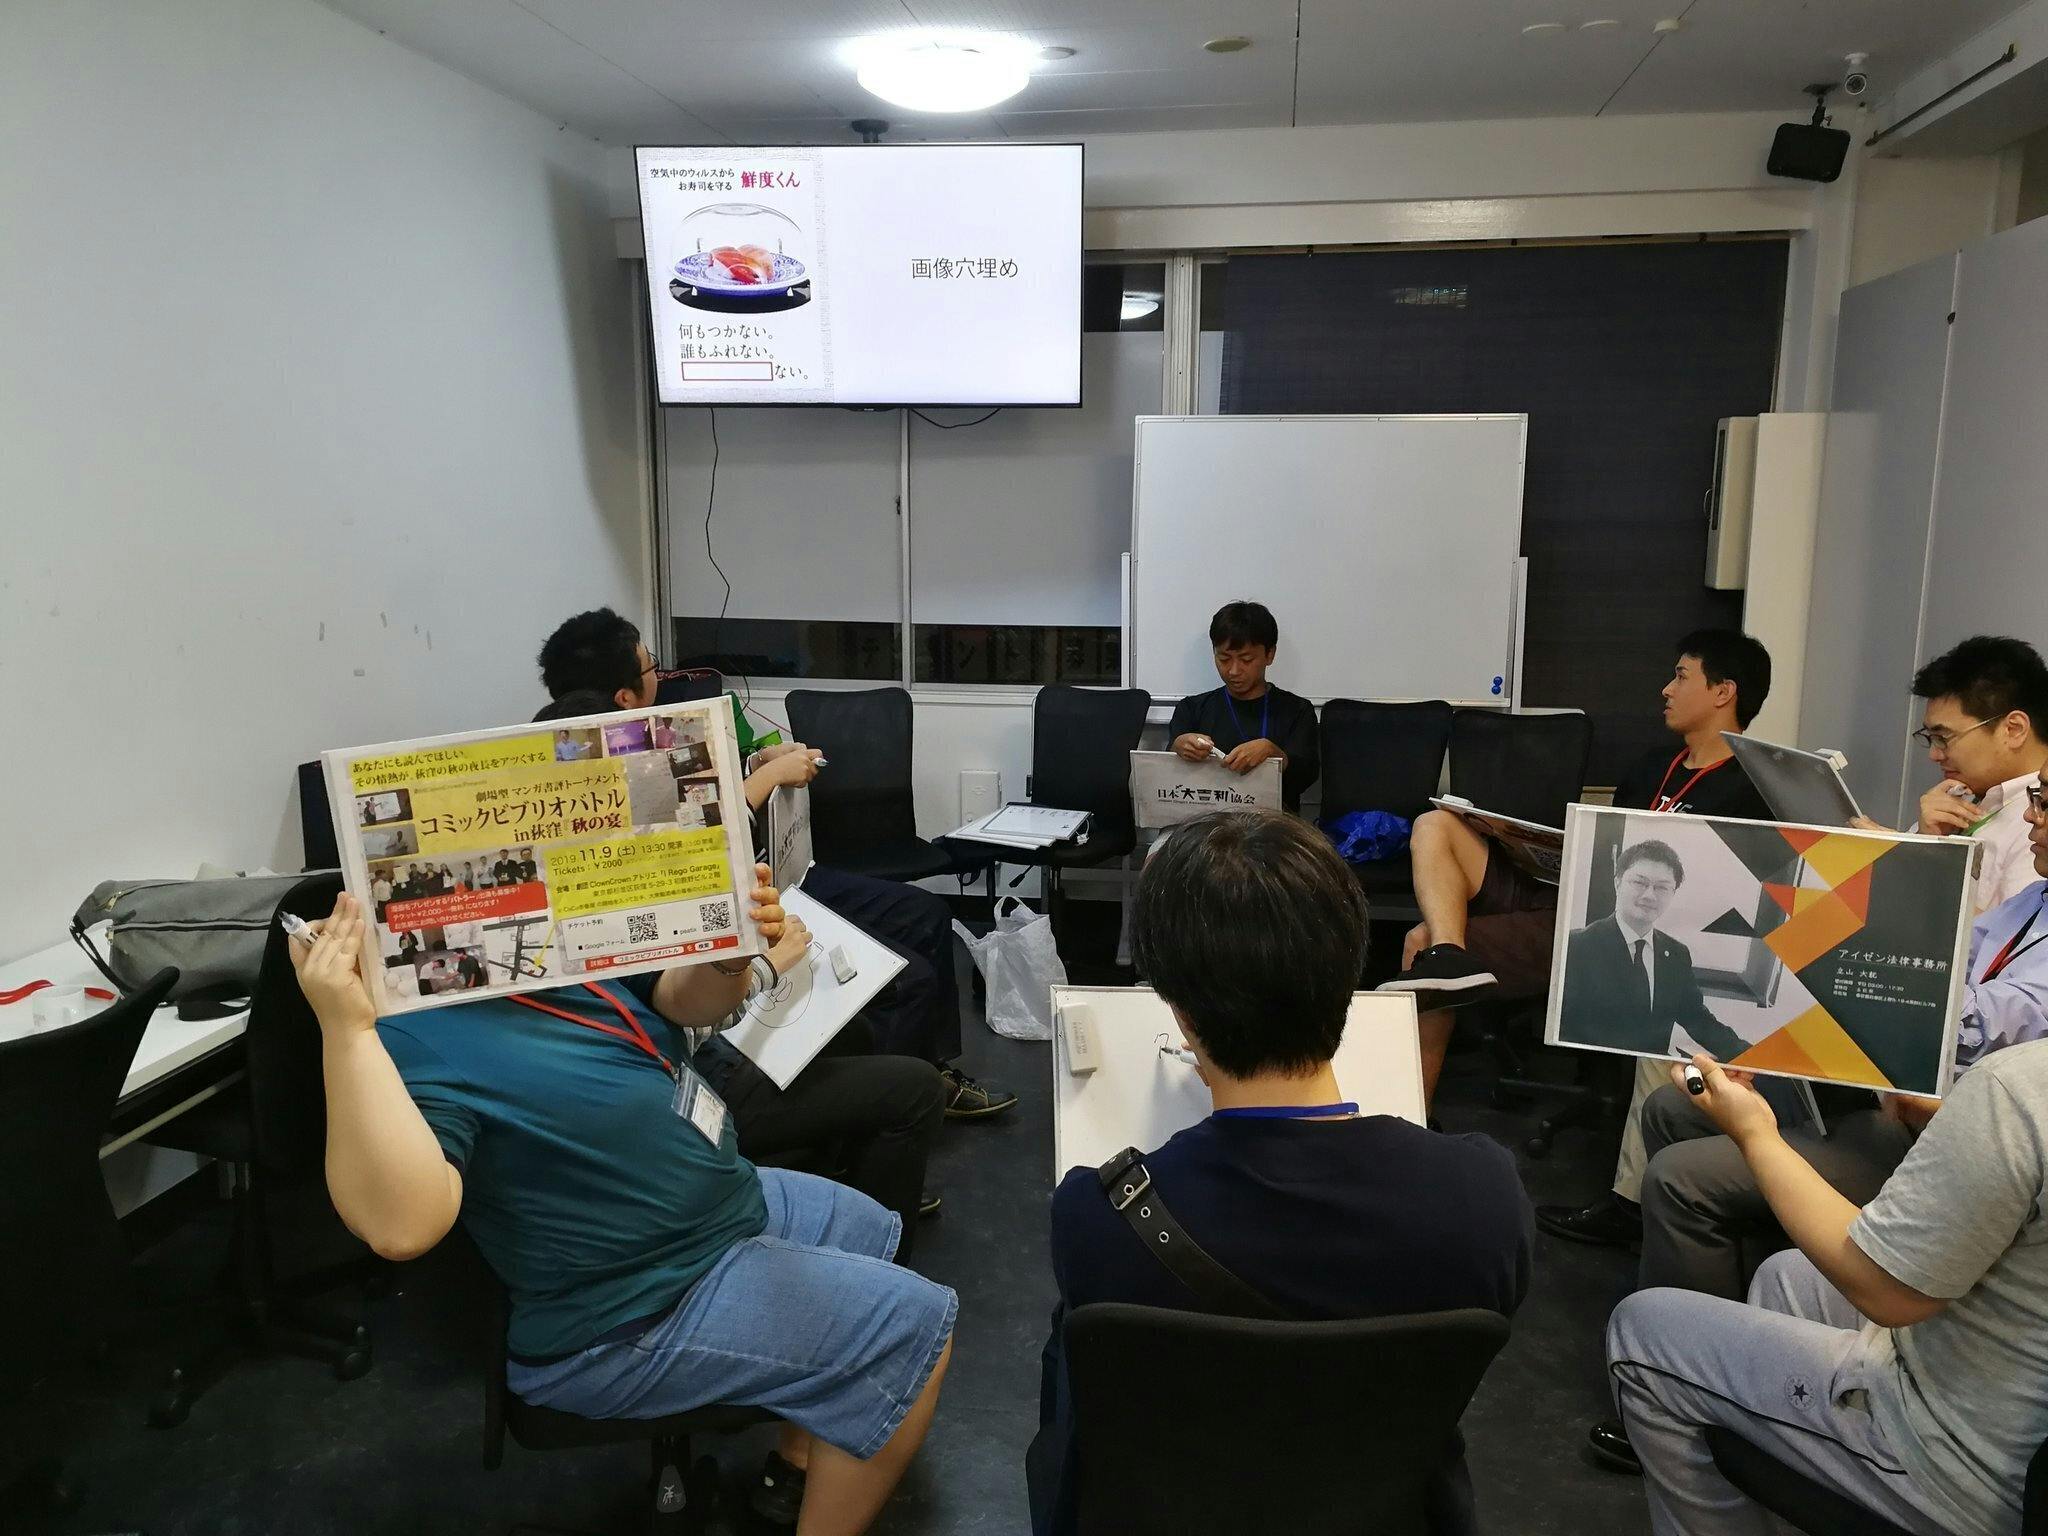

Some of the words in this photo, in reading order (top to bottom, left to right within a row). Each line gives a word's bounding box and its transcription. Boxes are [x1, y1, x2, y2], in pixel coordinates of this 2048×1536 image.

[650, 168, 735, 178] 空気中のウィルスから
[741, 170, 801, 189] 鮮度くん
[678, 181, 733, 191] お寿司を守る
[911, 257, 1018, 279] 画像穴埋め
[679, 324, 773, 339] 何もつかない。
[680, 343, 774, 359] 誰もふれない。
[775, 364, 808, 379] ない。
[420, 789, 625, 836] コミックビブリオバトル
[551, 855, 576, 867] 2019
[580, 846, 612, 861] 11.9
[641, 843, 665, 853] 13:30
[590, 877, 632, 888] ClownCrown
[1839, 949, 1948, 971] アイゼン法律事務所
